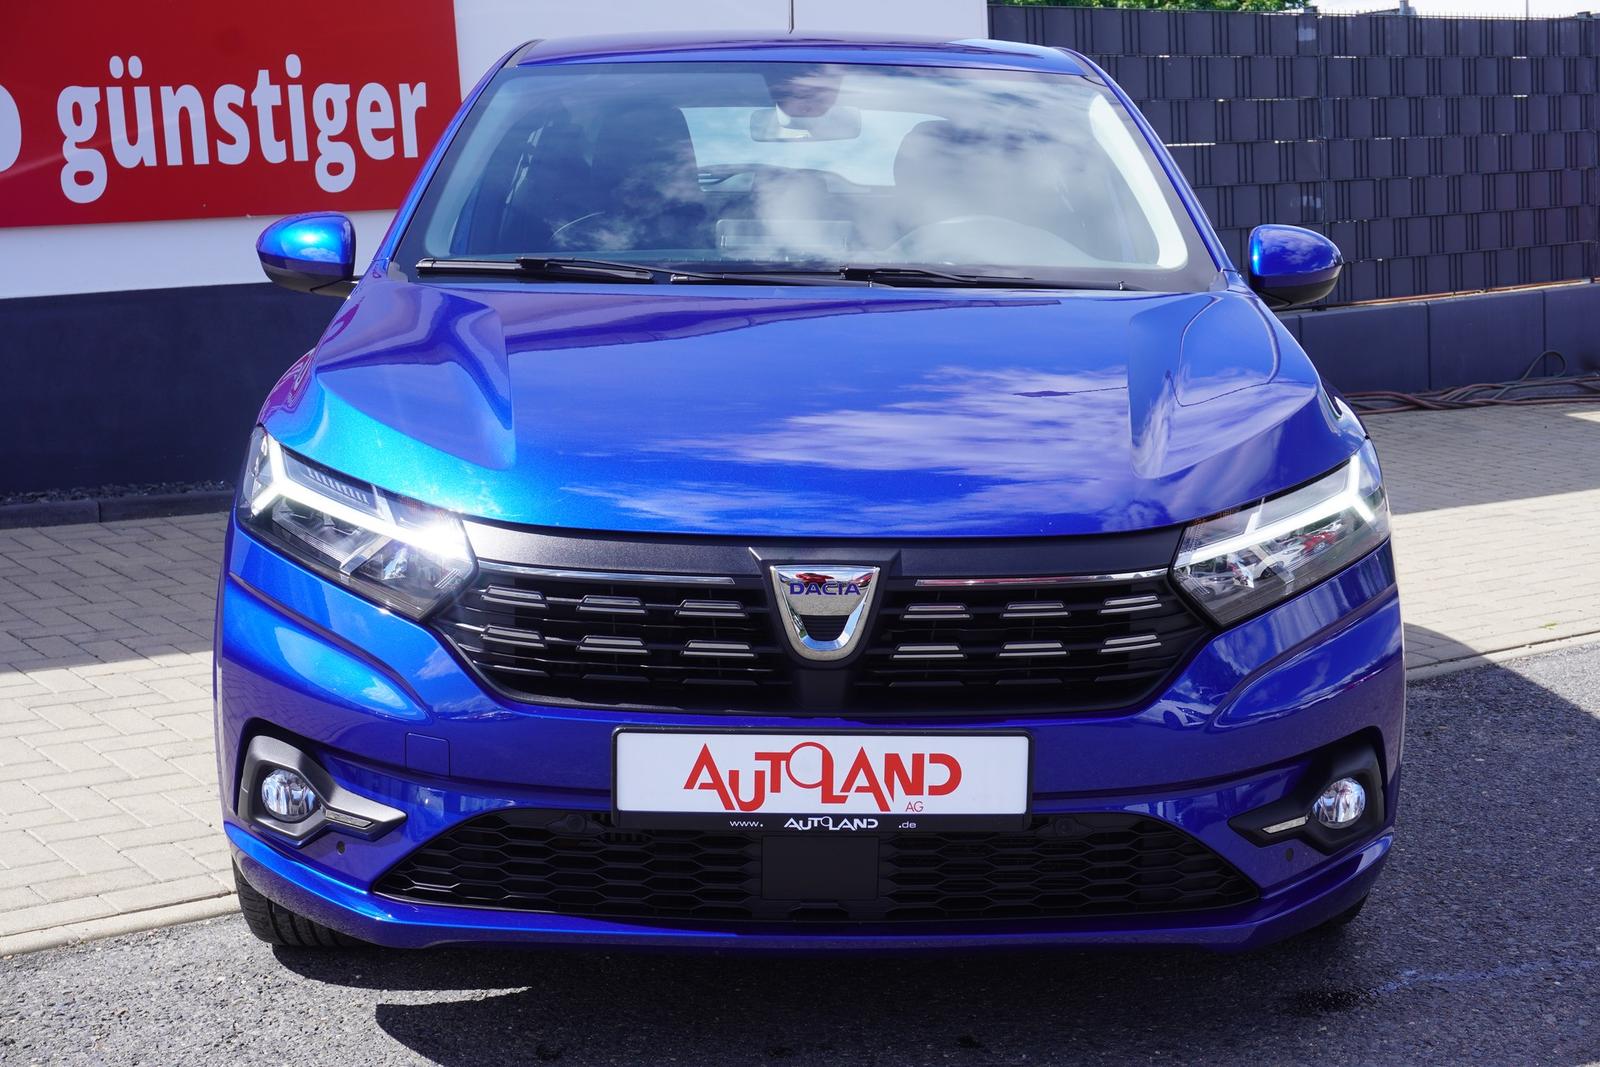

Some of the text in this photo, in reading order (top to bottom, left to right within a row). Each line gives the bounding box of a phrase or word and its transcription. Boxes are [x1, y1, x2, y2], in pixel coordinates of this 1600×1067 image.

[57, 54, 427, 204] günstiger
[789, 583, 861, 596] DACIA
[683, 741, 962, 812] AUTOLAND
[905, 801, 924, 812] AG
[729, 816, 917, 831] www. AUTOLAND .de
